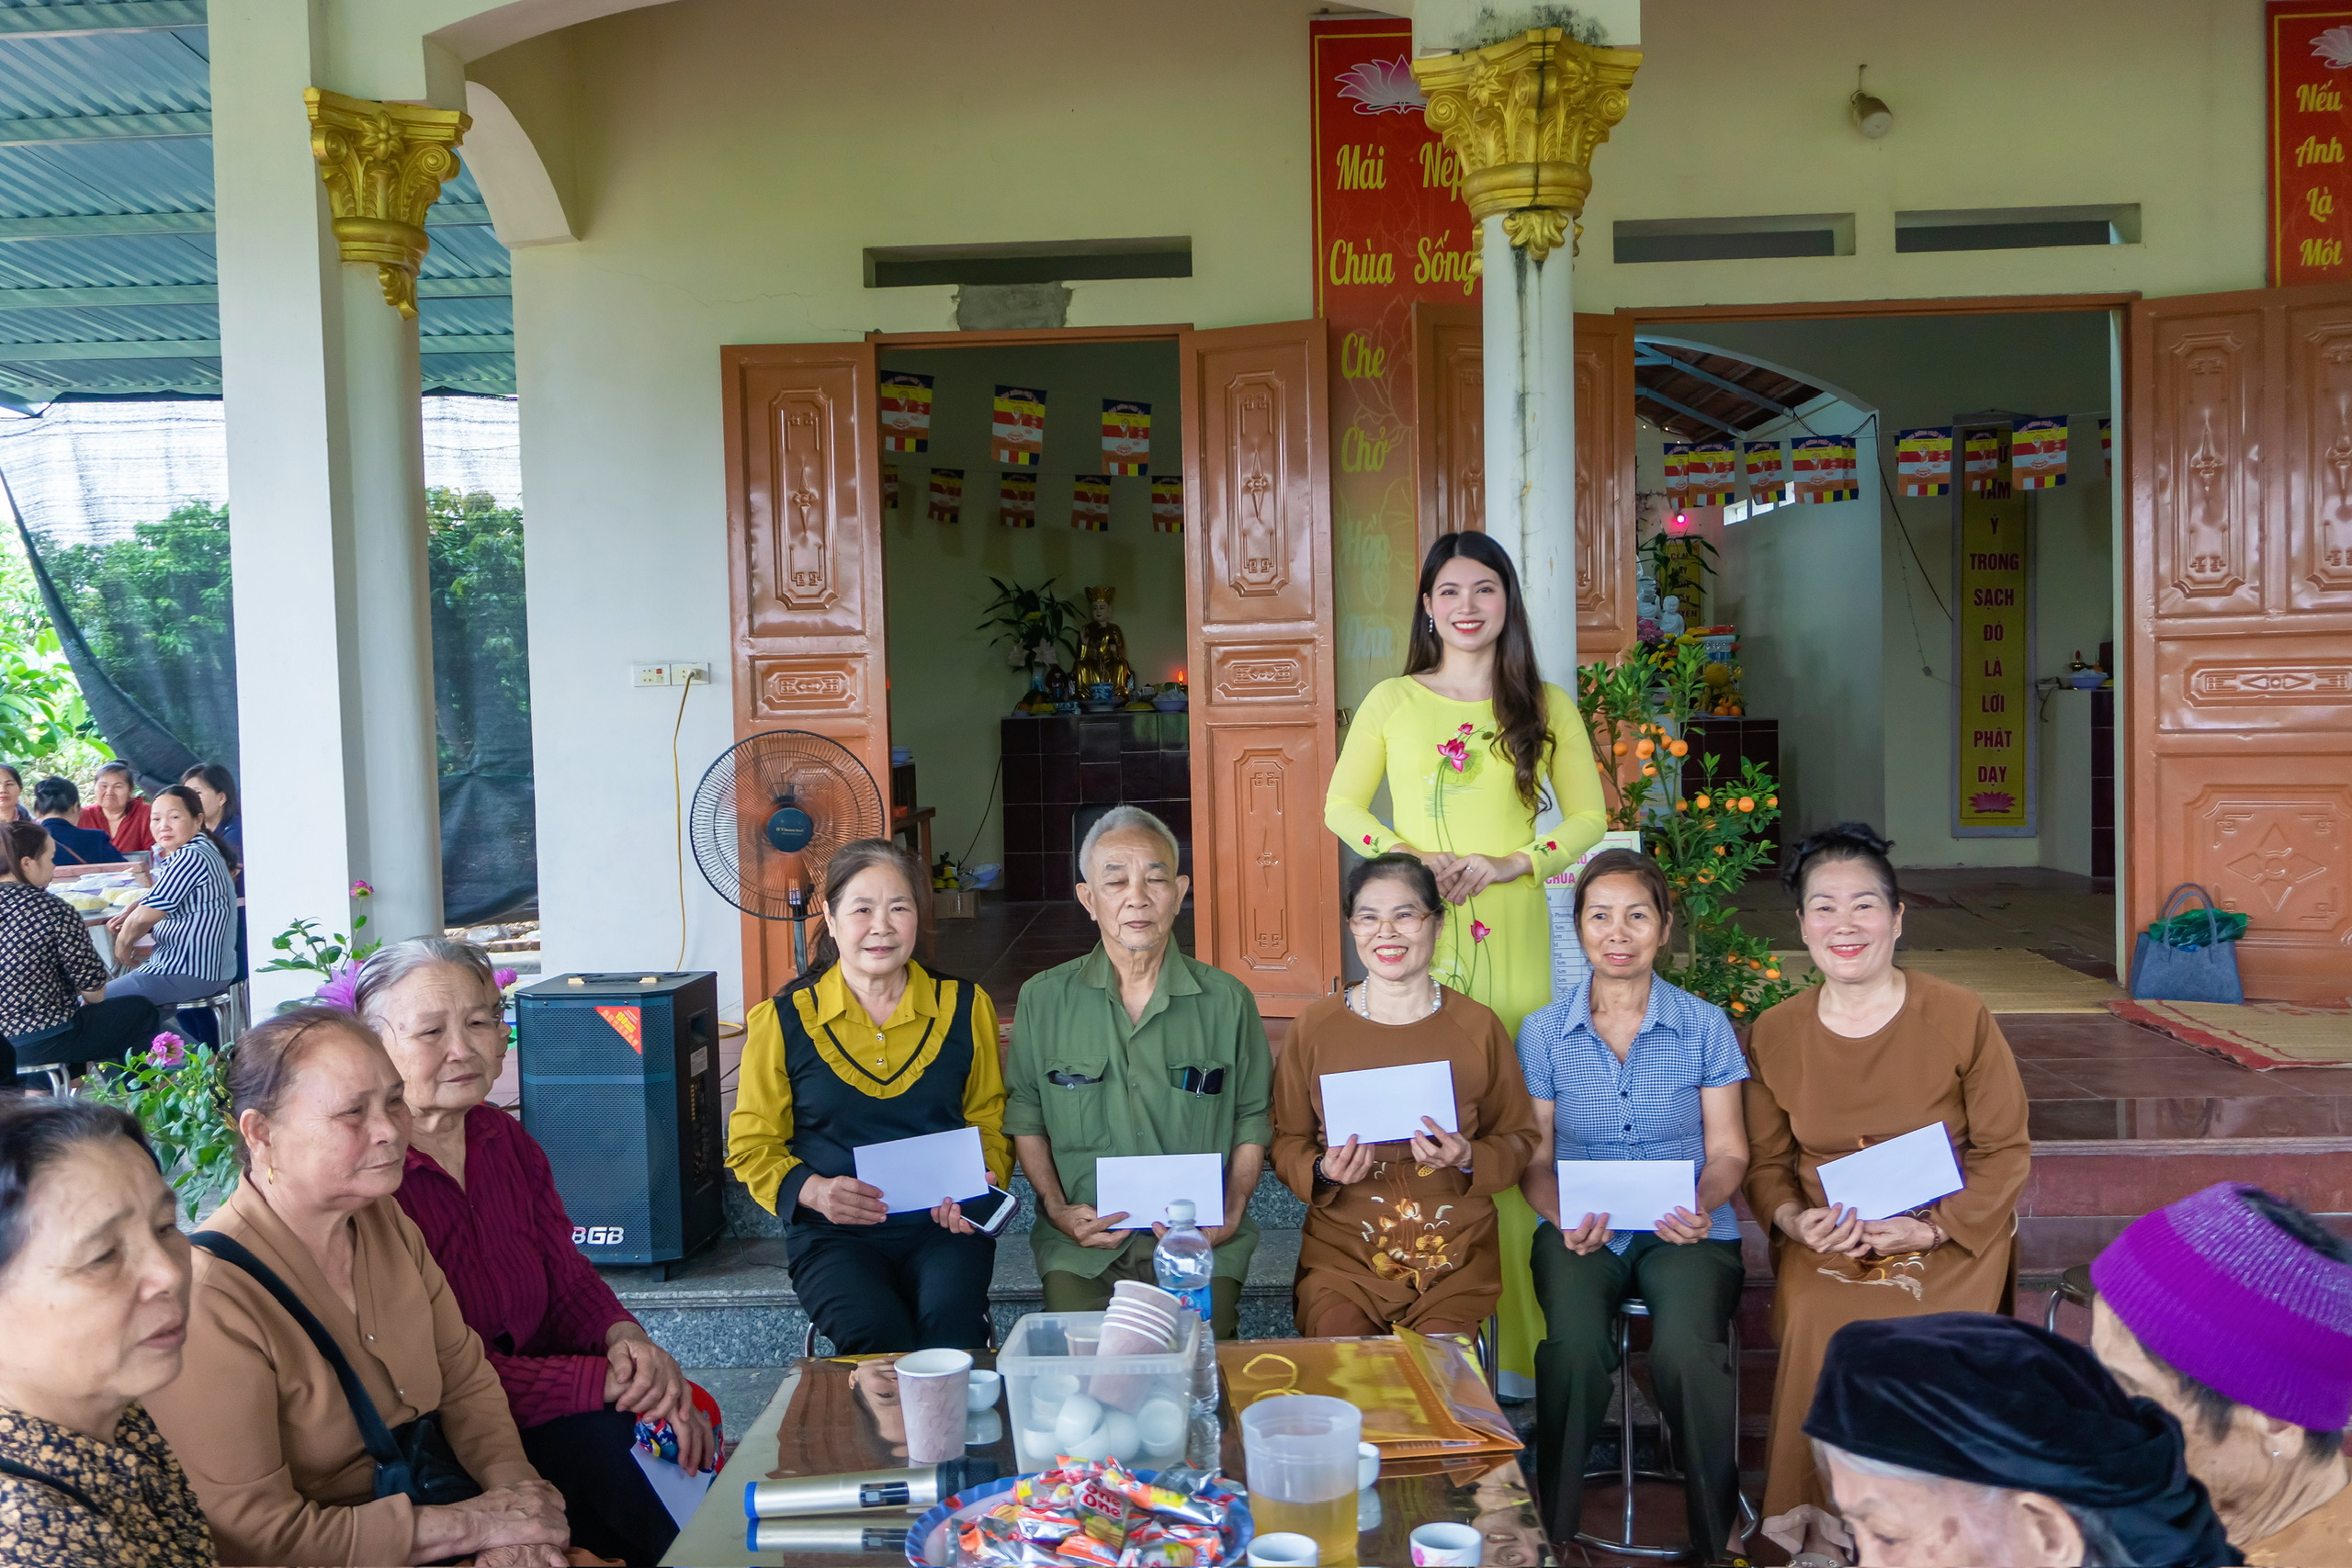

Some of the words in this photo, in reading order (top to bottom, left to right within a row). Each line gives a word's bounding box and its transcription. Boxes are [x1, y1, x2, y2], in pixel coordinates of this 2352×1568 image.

[2296, 80, 2343, 112] Nếu
[2295, 135, 2345, 167] Anh
[1336, 143, 1386, 190] Mái
[2306, 186, 2334, 223] Là
[1329, 238, 1396, 286] Chùa
[1414, 230, 1477, 296] Sống
[1341, 333, 1385, 379] Che
[1340, 425, 1390, 473] Chở
[1969, 553, 2019, 571] TRONG
[1973, 588, 2015, 611] SẠCH
[1983, 621, 2005, 642] ĐÓ
[1984, 656, 2003, 678] LÀ
[1981, 691, 2005, 714] LỜI
[1973, 727, 2012, 752] PHẬT
[1977, 765, 2007, 787] DẠY
[571, 1226, 625, 1246] BGB
[1081, 1493, 1122, 1519] One
